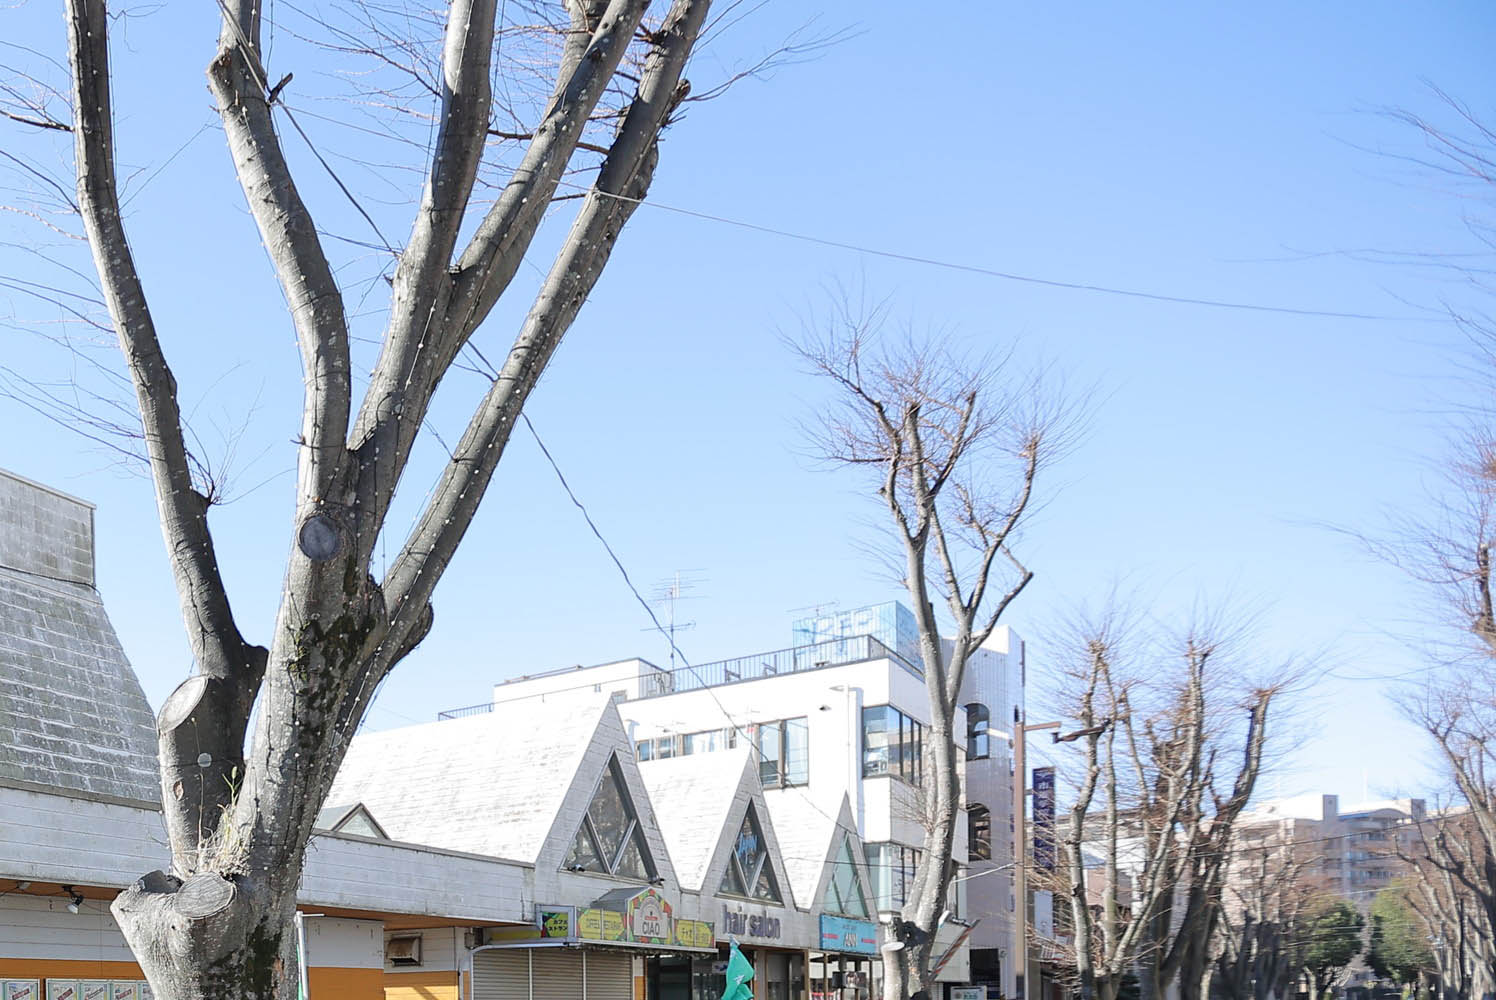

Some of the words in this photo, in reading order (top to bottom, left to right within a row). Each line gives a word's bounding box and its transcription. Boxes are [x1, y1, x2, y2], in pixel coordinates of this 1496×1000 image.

[642, 922, 660, 935] CIAO
[722, 903, 747, 935] hair
[749, 910, 781, 939] salon
